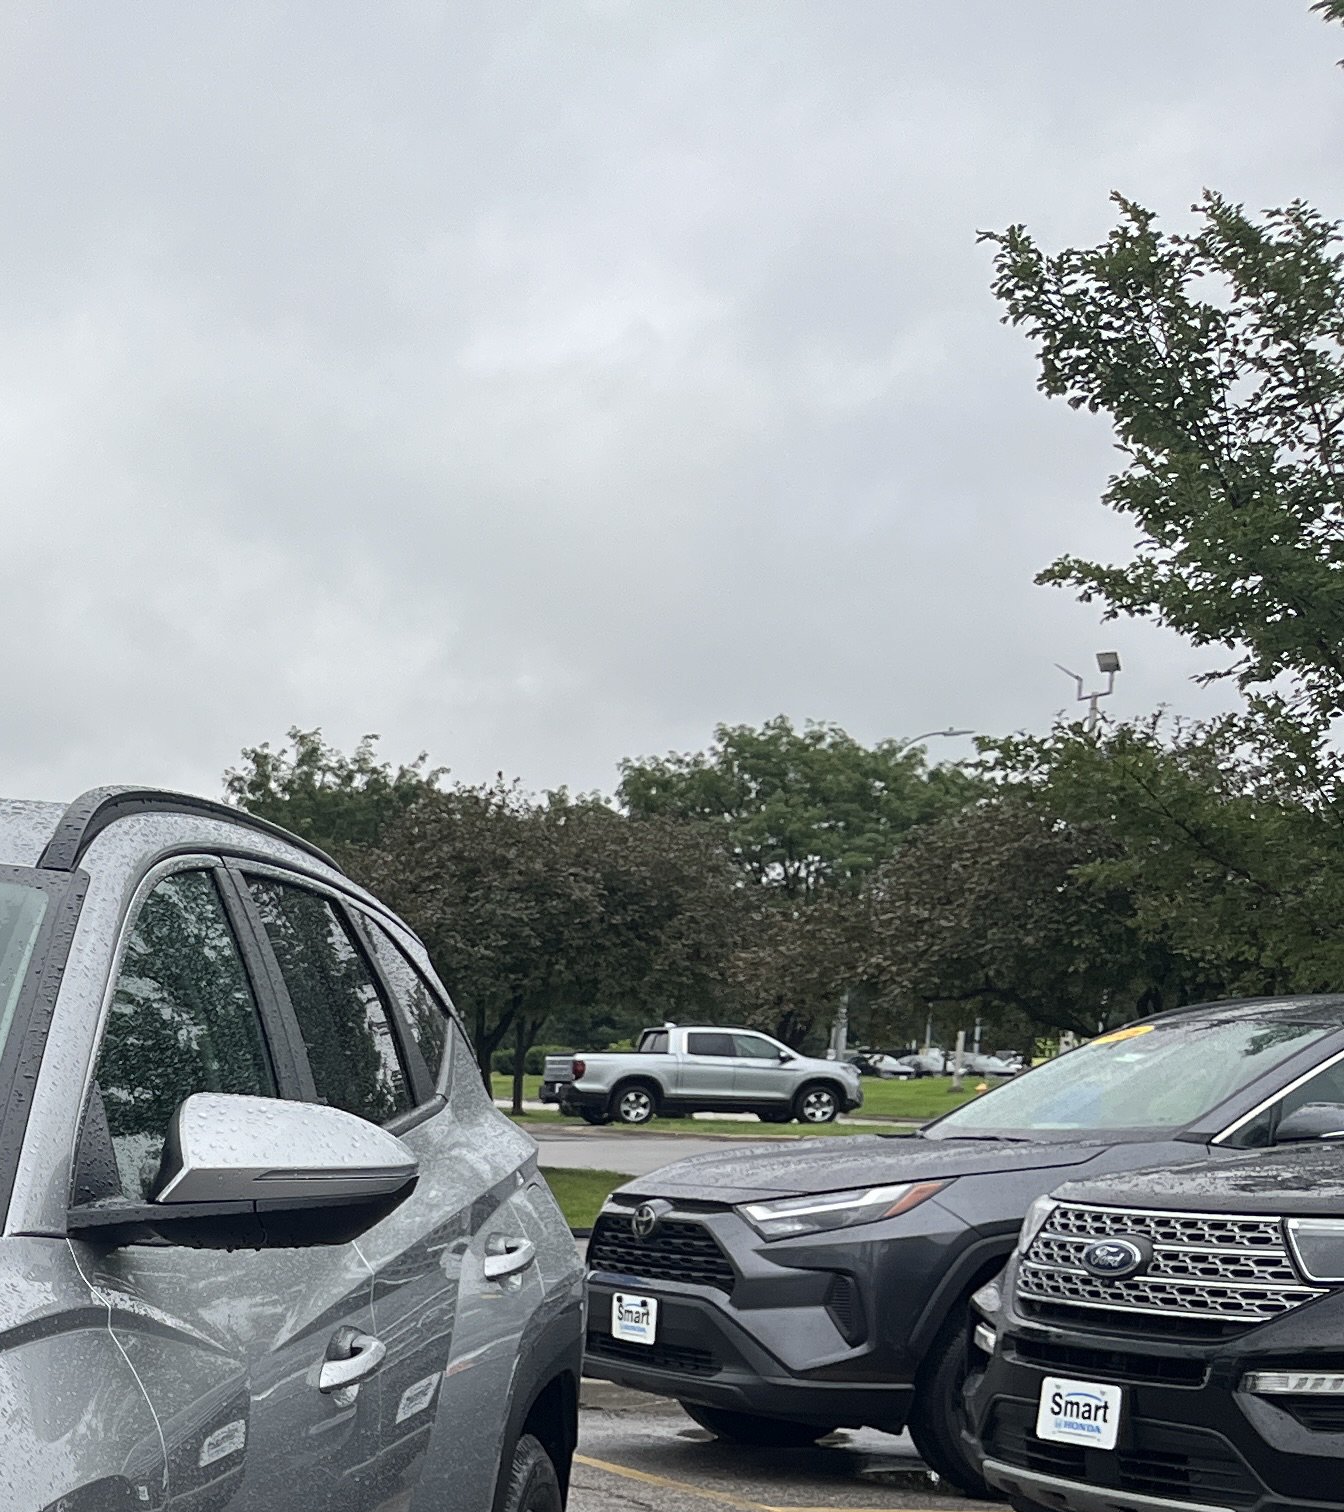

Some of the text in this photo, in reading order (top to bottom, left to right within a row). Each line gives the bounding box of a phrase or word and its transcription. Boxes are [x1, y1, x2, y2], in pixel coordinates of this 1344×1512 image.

[1091, 1245, 1125, 1268] Ford
[617, 1303, 650, 1326] Smart
[1049, 1391, 1110, 1424] Smart
[1063, 1420, 1102, 1435] HONDA
